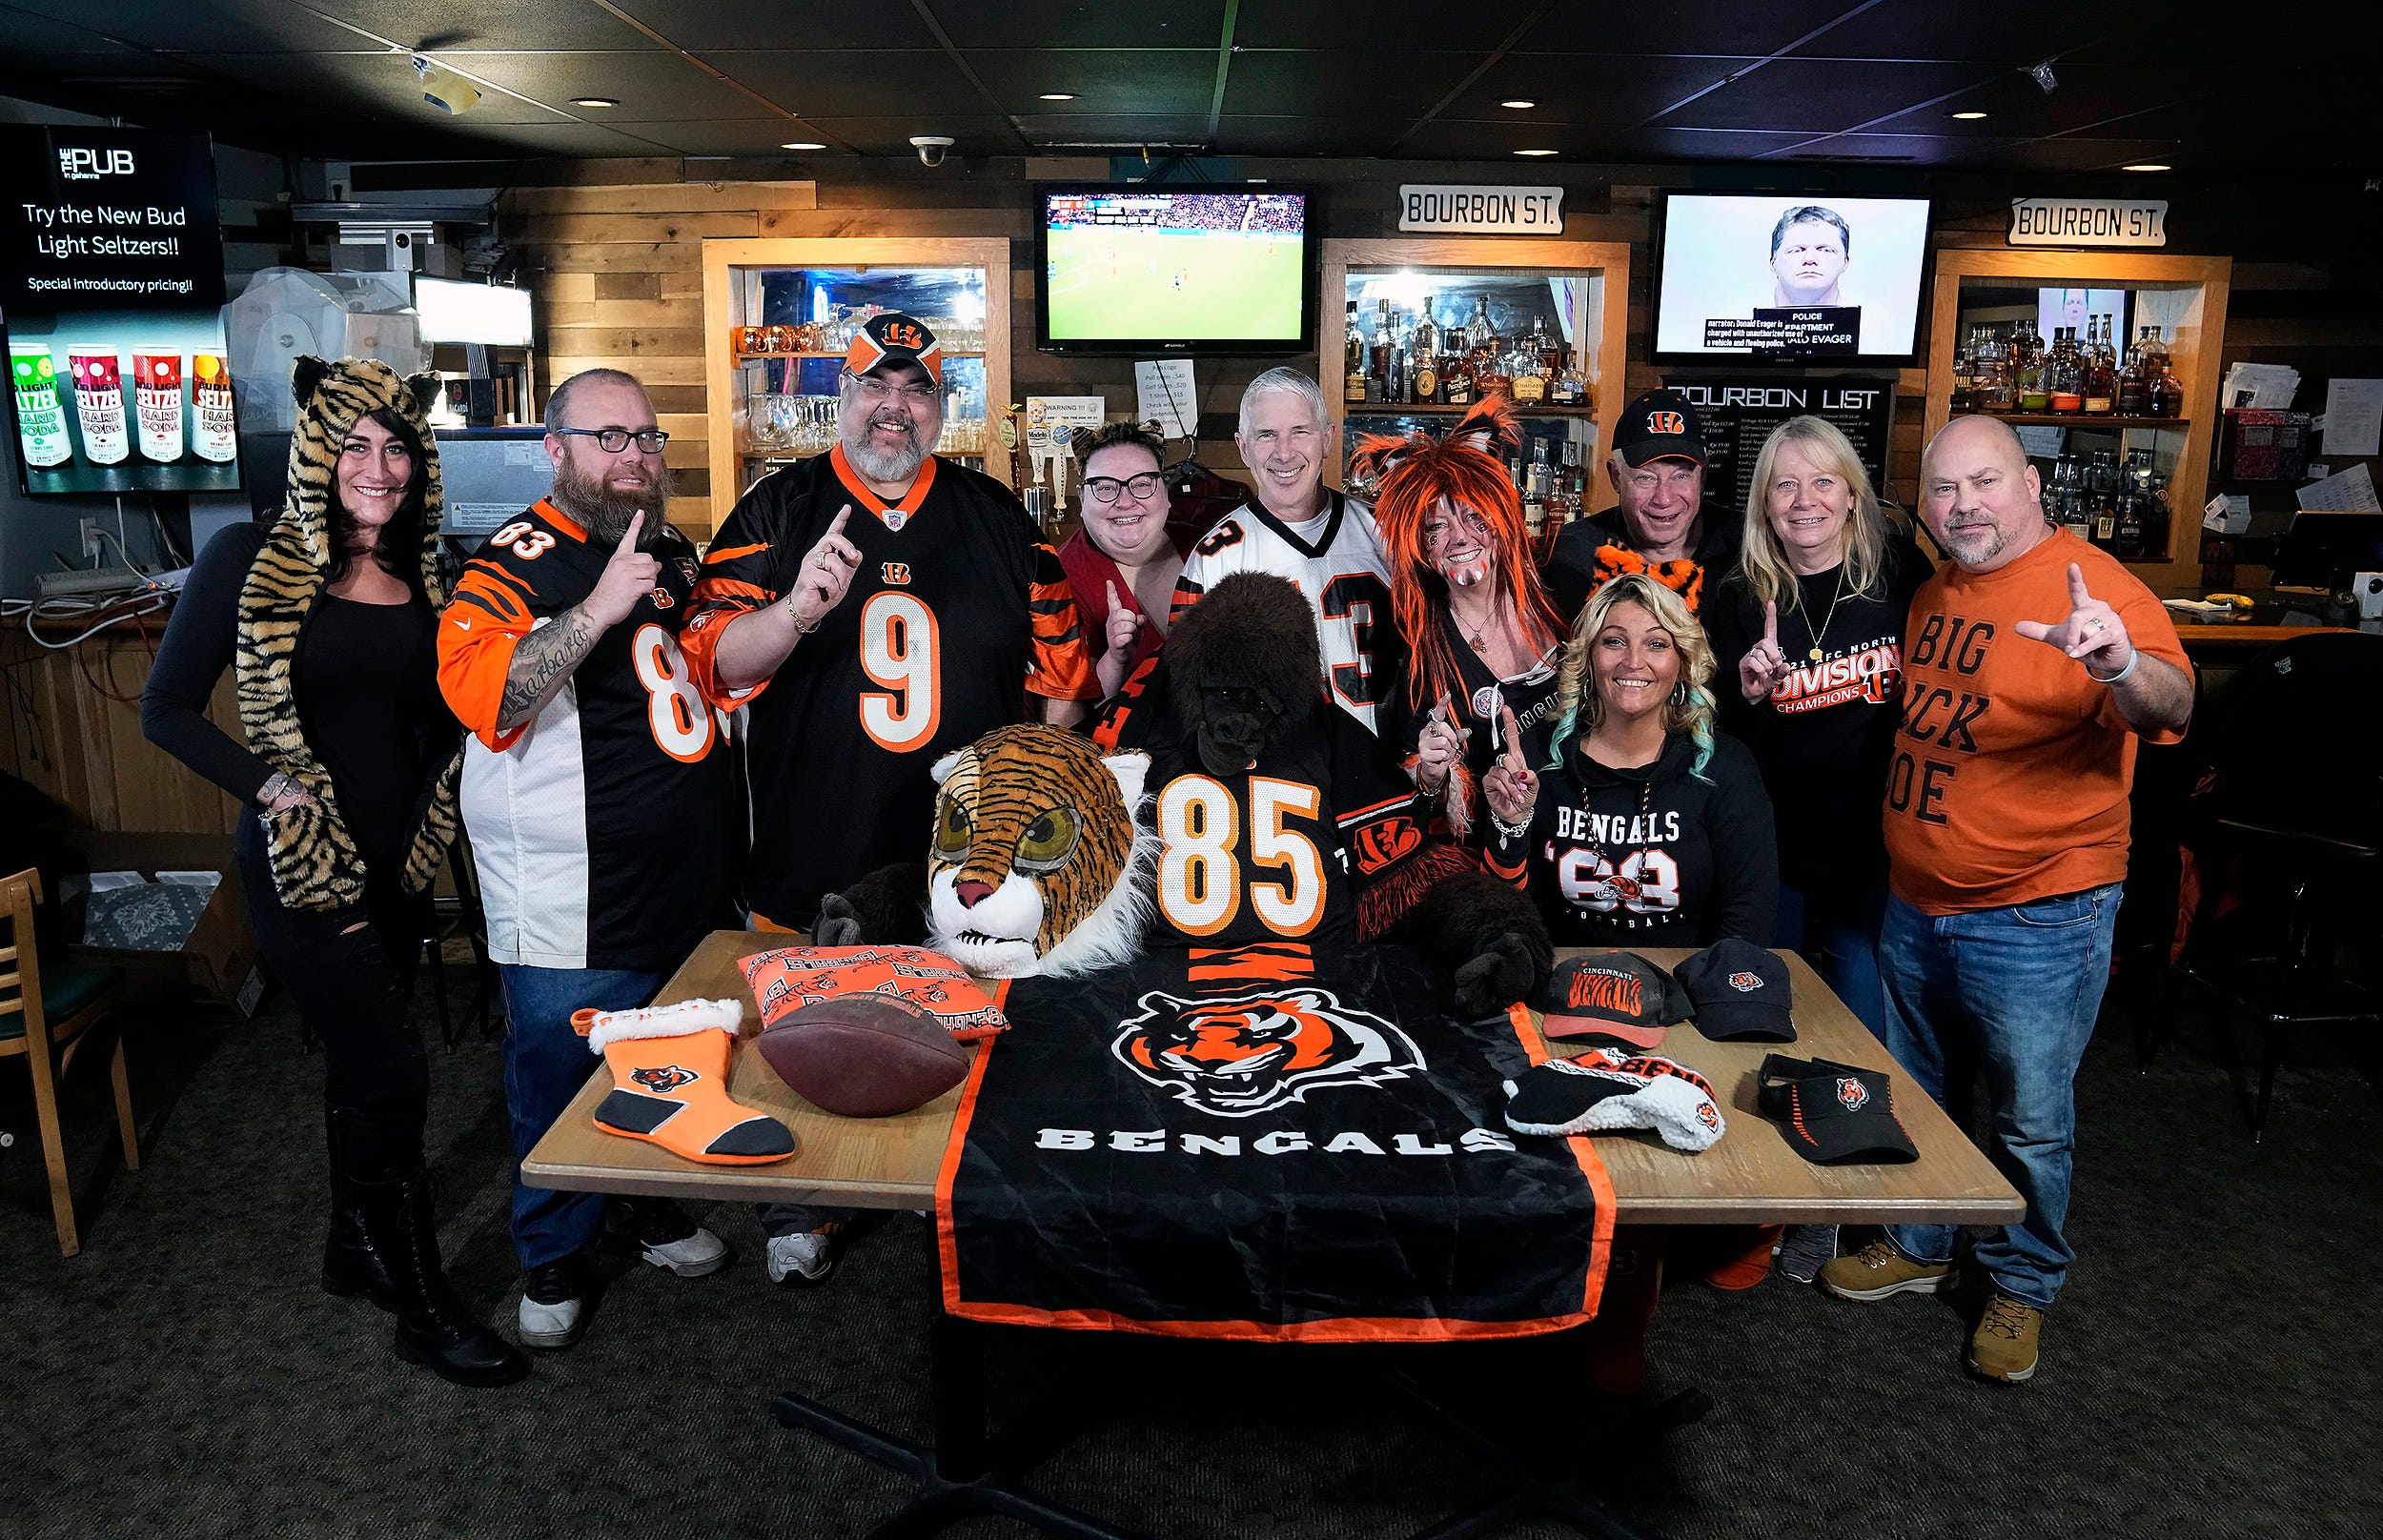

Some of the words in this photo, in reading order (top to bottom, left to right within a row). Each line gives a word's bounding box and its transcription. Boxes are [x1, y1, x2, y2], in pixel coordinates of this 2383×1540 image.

[71, 149, 134, 174] PUB
[23, 204, 55, 227] Try
[59, 204, 92, 224] the
[97, 205, 141, 224] New
[147, 207, 185, 225] Bud
[1408, 193, 1516, 224] BOURBON
[1524, 195, 1555, 225] ST.
[2019, 207, 2122, 235] BOURBON
[2129, 209, 2158, 237] ST.
[38, 234, 88, 258] Light
[92, 235, 179, 255] Seltzers!!
[28, 277, 71, 292] Special
[73, 277, 145, 293] introductory
[147, 279, 193, 294] pricing!!
[1707, 329, 1732, 337] charged
[1784, 323, 1834, 332] EPARTMENT
[1812, 334, 1852, 344] EVAGER
[21, 382, 52, 392] LIGHT
[91, 382, 118, 391] LIGHT
[155, 382, 180, 391] LIGHT
[199, 382, 221, 391] BUD
[1668, 386, 1806, 409] OURBON
[1823, 389, 1880, 410] LIST
[81, 411, 120, 423] HARD
[140, 409, 178, 421] HARD
[142, 420, 179, 433] SODA
[203, 410, 234, 421] HAR
[203, 421, 234, 433] SOD
[83, 422, 122, 435] SODA
[1294, 572, 1394, 707] 3
[1910, 613, 1997, 676] BIG
[1790, 660, 1806, 670] 21
[1850, 636, 1896, 654] NORTH
[859, 590, 941, 753] 9
[632, 622, 730, 764] 8
[1777, 686, 1860, 713] CHAMPIONS
[1904, 680, 1993, 755] ICK
[1887, 749, 1959, 828] OE
[1557, 806, 1680, 844] BENGALS
[1157, 773, 1327, 938] 85
[1583, 967, 1632, 981] CINCINNATI
[1567, 971, 1641, 1017] BENGALS
[1035, 1126, 1517, 1156] BENGALS
